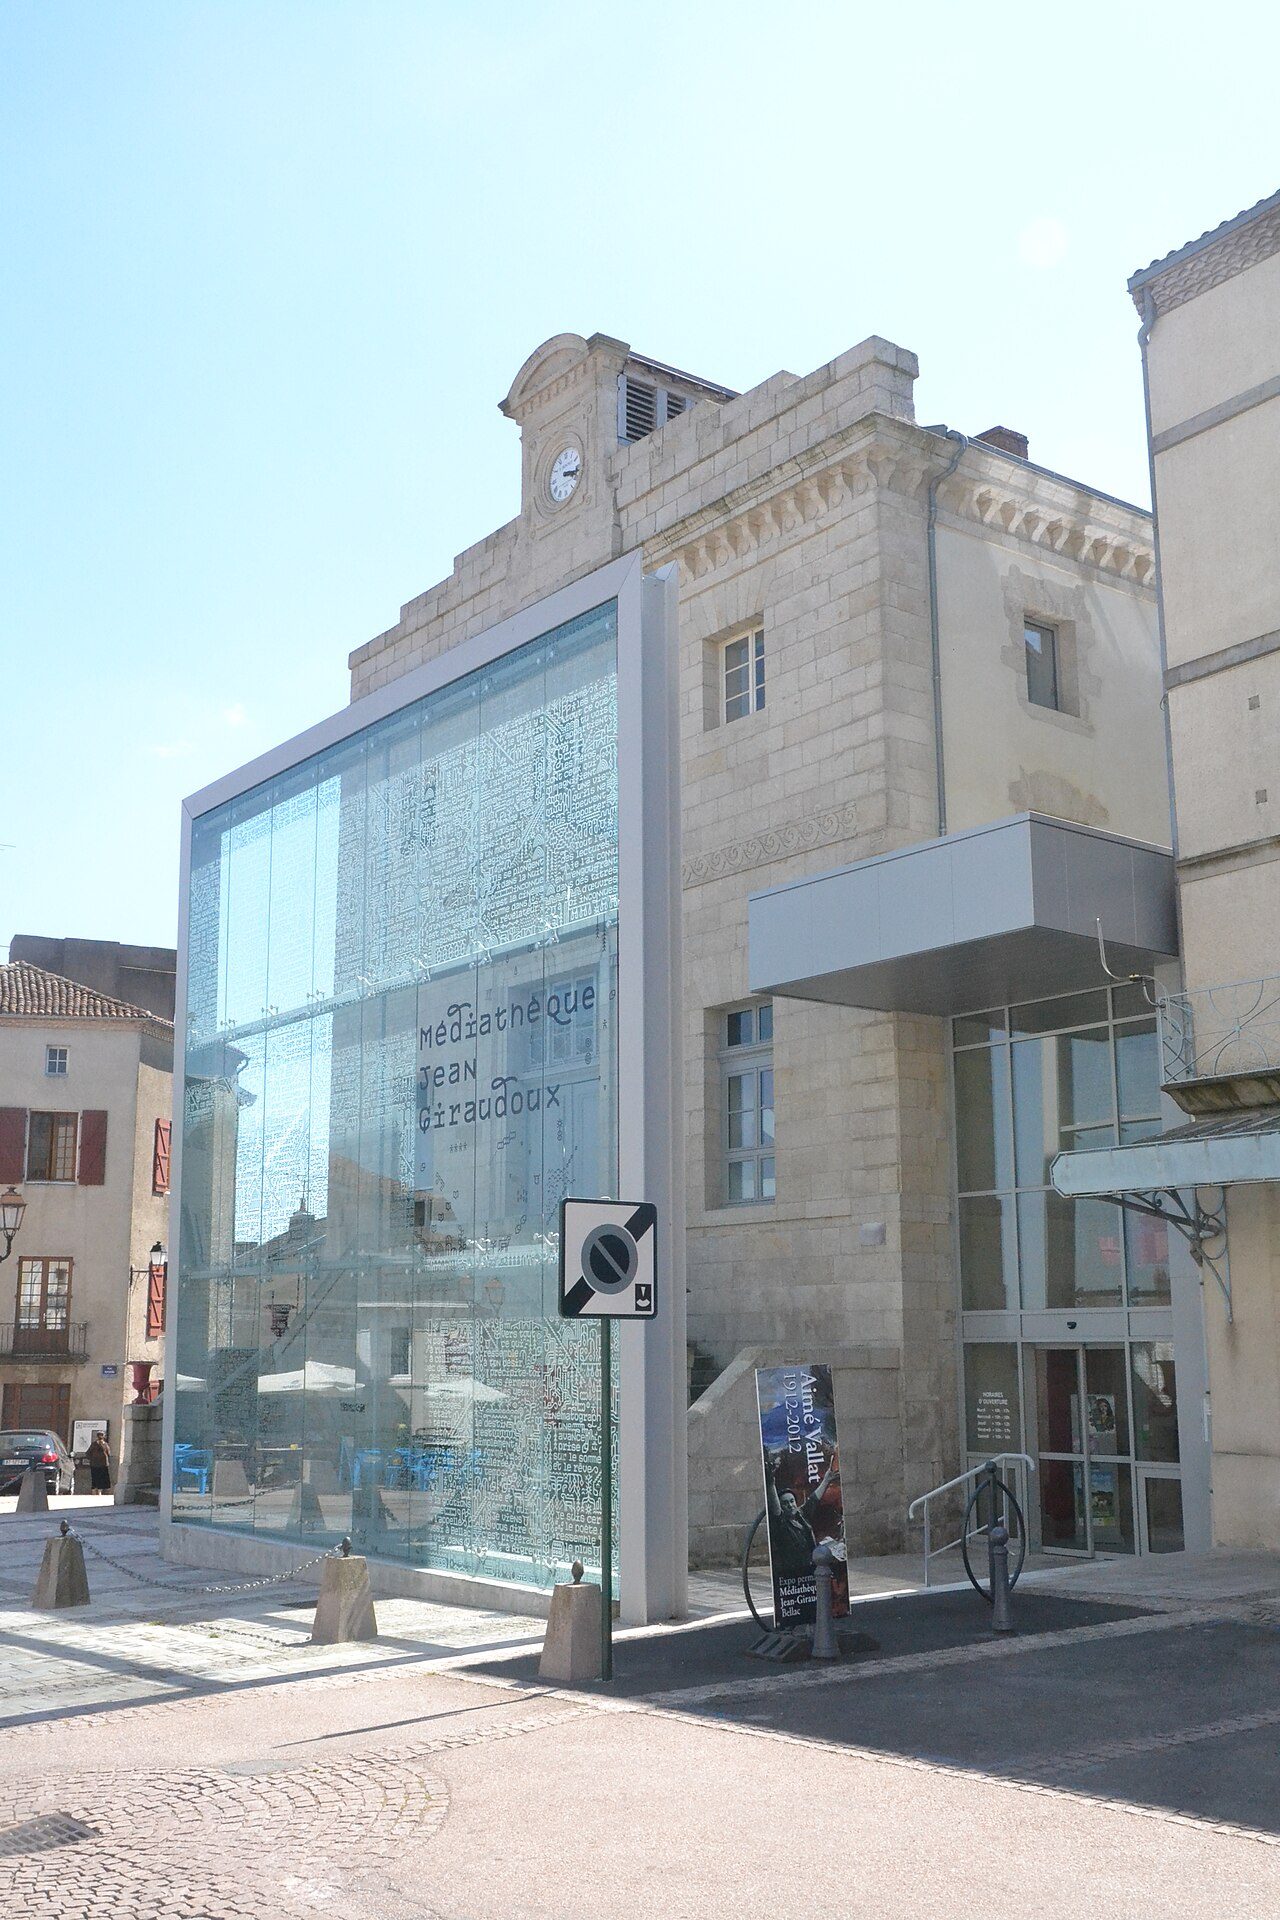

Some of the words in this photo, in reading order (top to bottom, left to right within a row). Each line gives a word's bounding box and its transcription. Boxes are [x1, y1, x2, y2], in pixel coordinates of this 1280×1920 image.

[419, 1076, 560, 1135] Giraudoux
[783, 1372, 802, 1454] 1912-2012
[800, 1371, 821, 1424] Aimé
[805, 1426, 825, 1484] Vallat
[779, 1576, 796, 1587] Expo
[780, 1584, 817, 1596] Médiathèqu
[780, 1595, 817, 1609] Jean-Girau
[782, 1606, 801, 1618] Bellac
